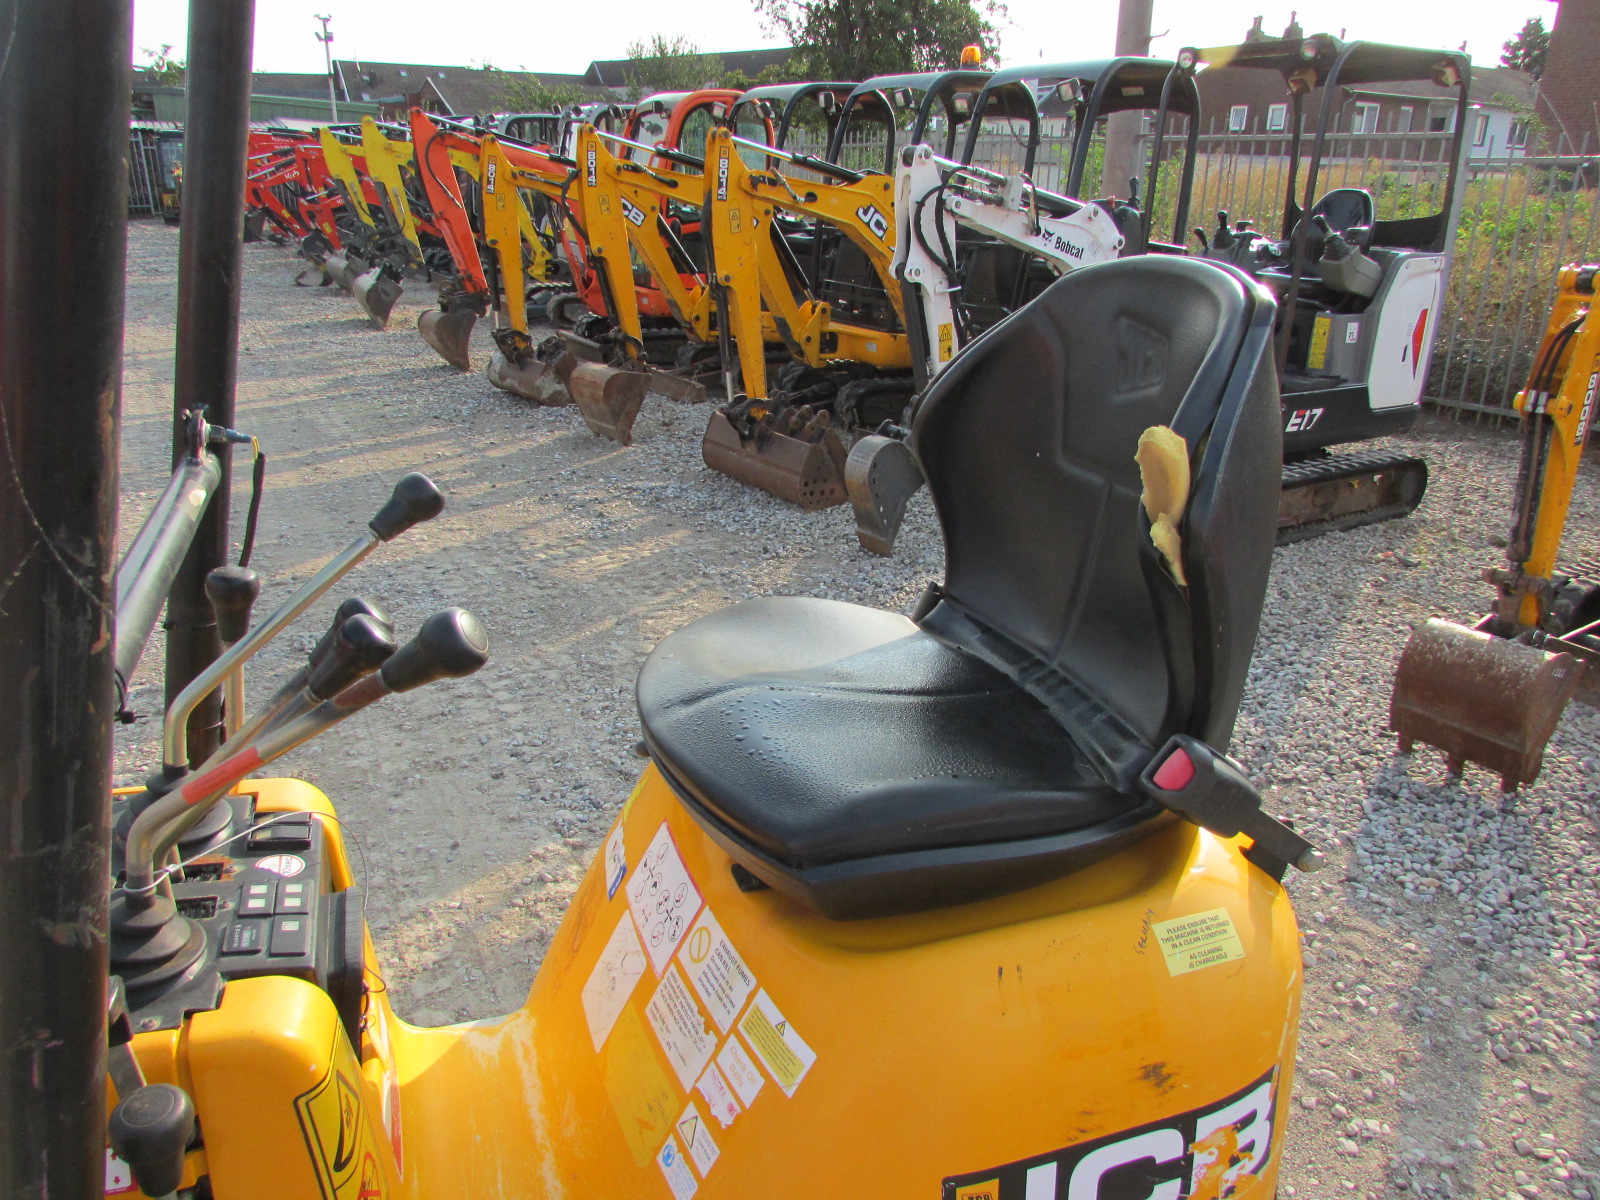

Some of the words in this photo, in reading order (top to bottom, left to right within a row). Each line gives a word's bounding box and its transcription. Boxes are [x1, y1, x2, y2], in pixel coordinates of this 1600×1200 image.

[487, 164, 495, 191] 8014
[587, 152, 596, 182] 8014
[718, 158, 728, 195] 8014
[621, 197, 645, 226] CB
[858, 206, 888, 241] JC
[1055, 236, 1083, 260] Bobcat
[1576, 373, 1597, 436] 8008
[1285, 407, 1323, 432] E17
[1167, 925, 1187, 935] PLEASE
[1188, 919, 1207, 929] ENSURE
[1208, 915, 1219, 923] THAT
[1175, 929, 1199, 940] MACHINE
[1206, 920, 1230, 931] RETURNED
[1184, 936, 1201, 946] CLEAN
[1201, 928, 1227, 940] CONDITION
[714, 947, 723, 962] CAN
[721, 958, 731, 974] KILL
[719, 938, 737, 967] EXHAUST
[735, 962, 751, 987] FUMES
[1195, 952, 1228, 967] CHARGEABLE
[1198, 946, 1223, 958] CLEANING
[727, 1061, 745, 1089] Daily
[729, 1043, 748, 1073] Check
[746, 1069, 757, 1086] Oil
